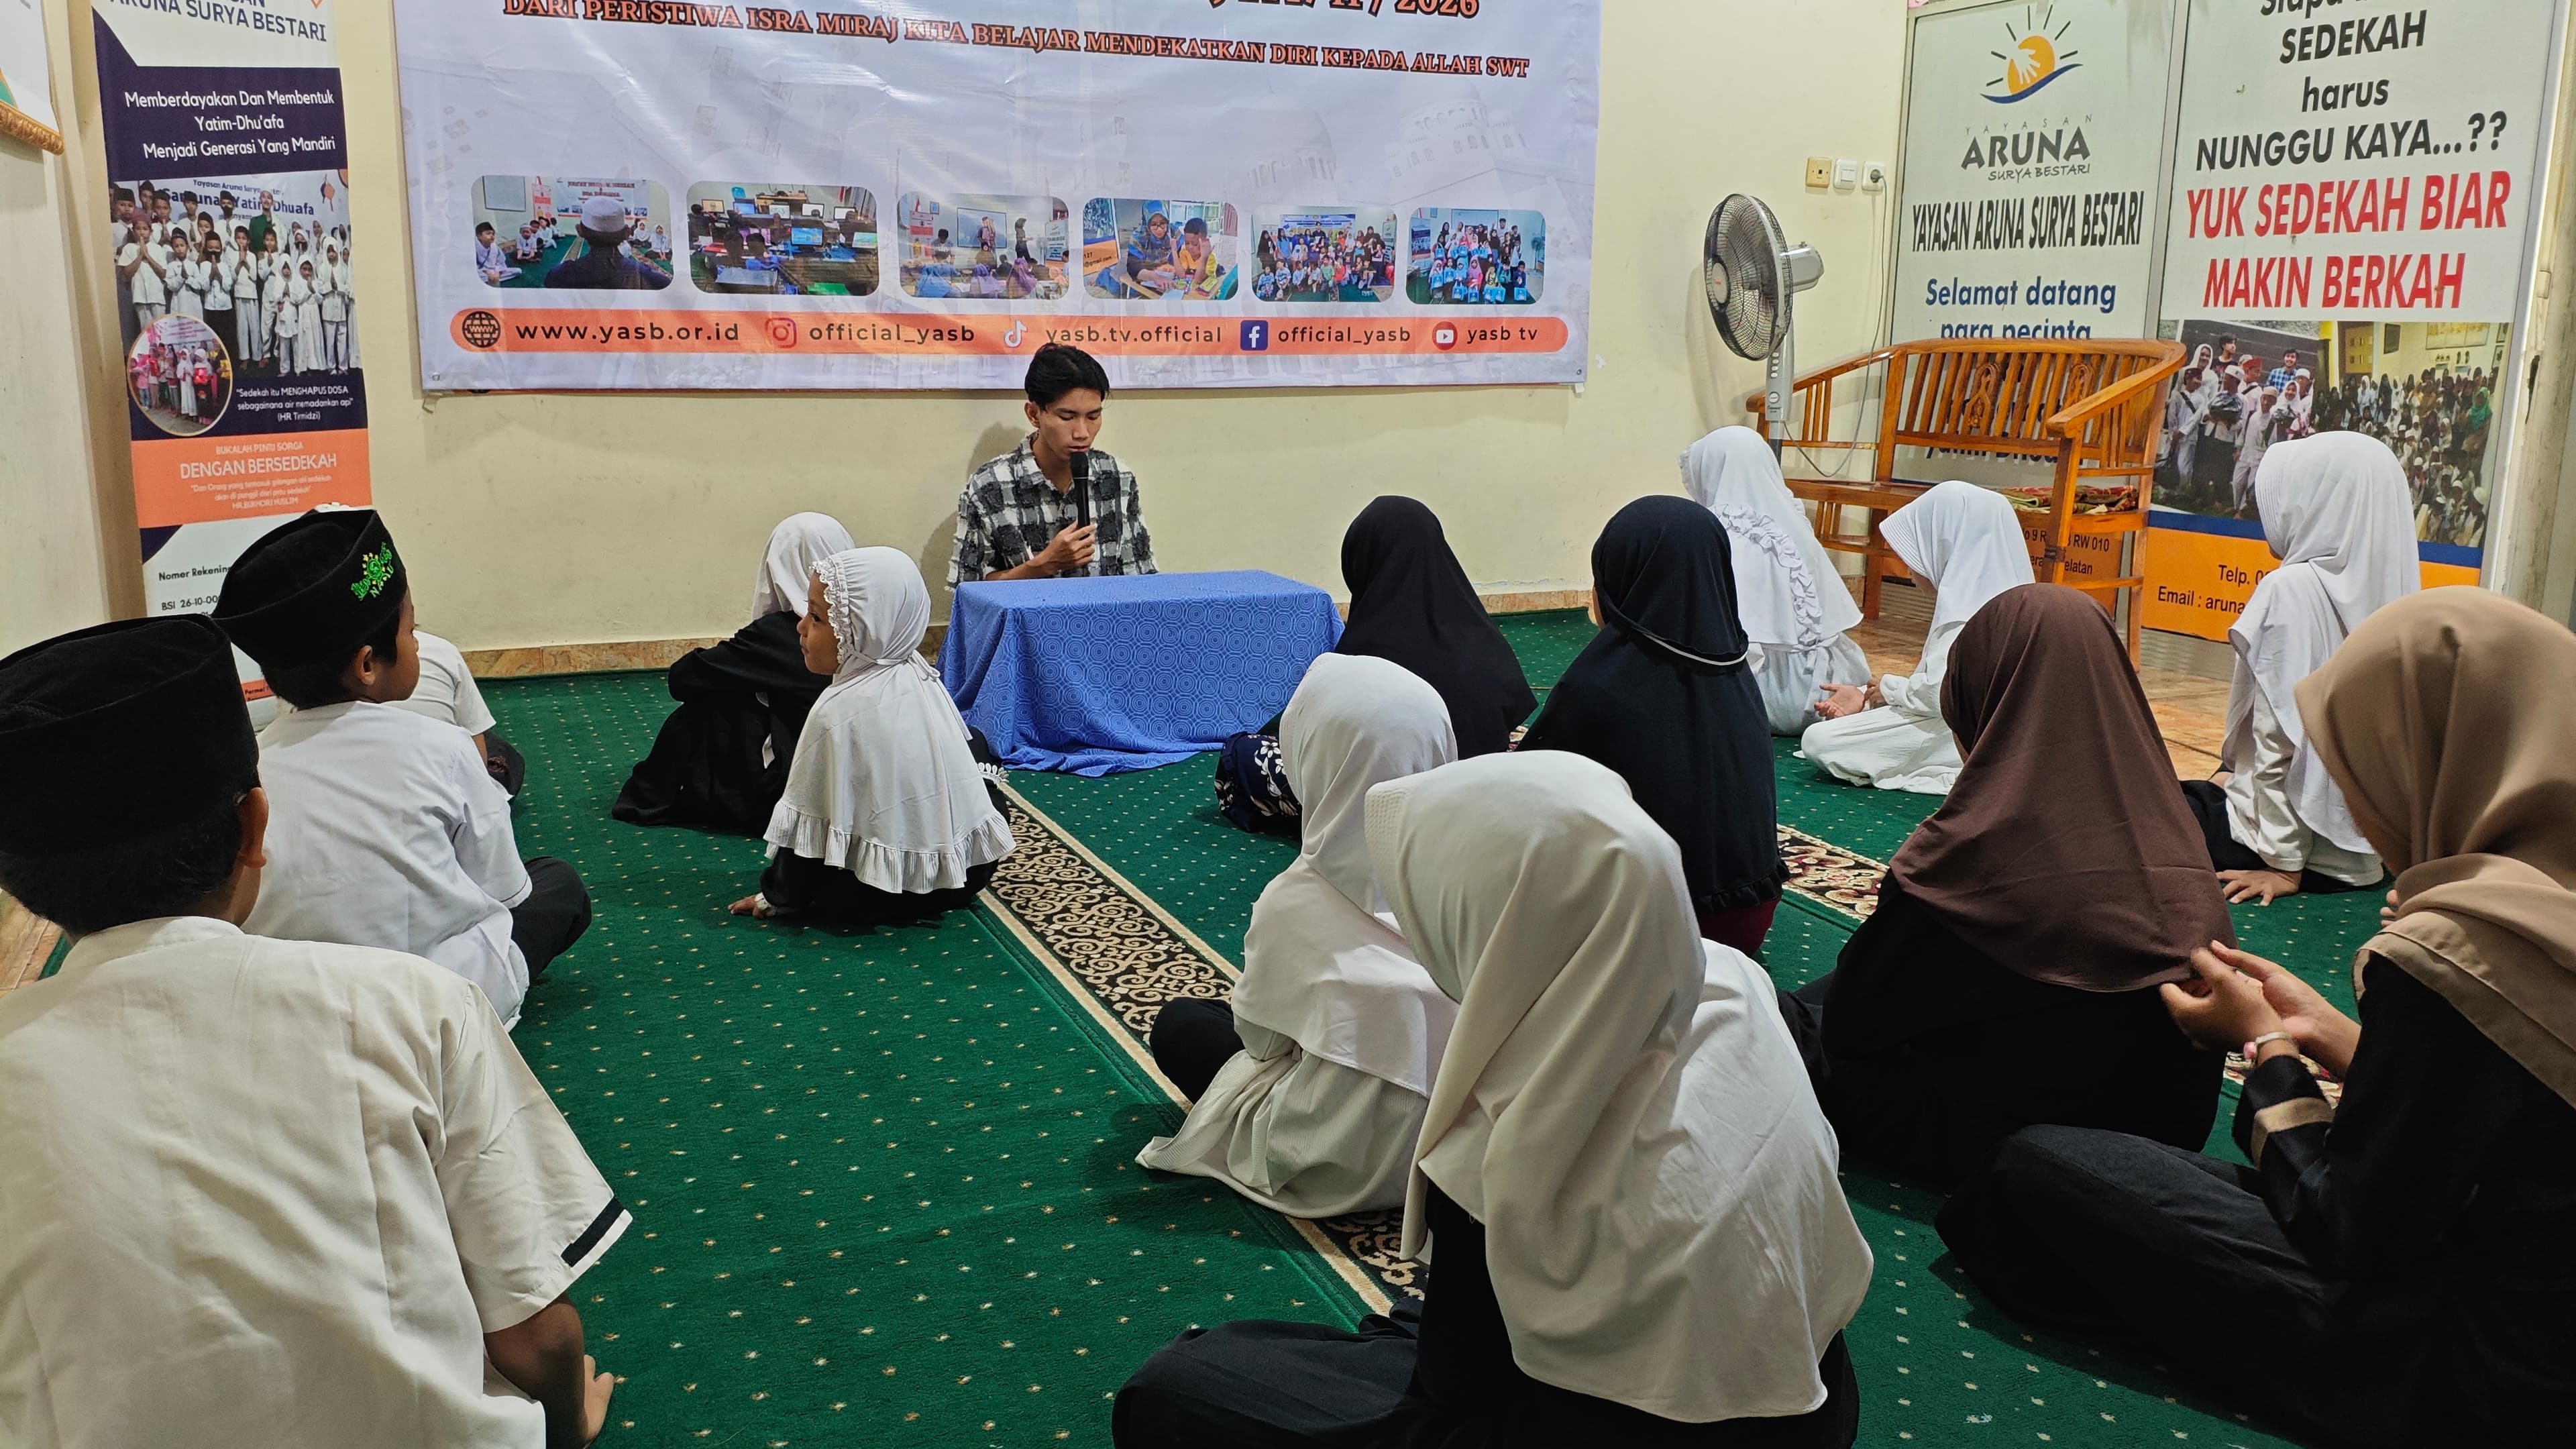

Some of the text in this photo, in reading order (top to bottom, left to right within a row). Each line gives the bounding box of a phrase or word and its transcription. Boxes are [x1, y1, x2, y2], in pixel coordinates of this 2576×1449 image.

[109, 0, 327, 42] UNA SURYA BESTARI
[503, 0, 1529, 78] DARI PERISTIWA ISRA MIRAJ KITA BELAJAR MENDEKATKAN DIRI KEPADA ALLAH SWT
[2279, 9, 2427, 64] SEDEKAH
[124, 89, 335, 110] Memberdayakan Dan Membentuk
[2301, 76, 2390, 113] harus
[194, 114, 284, 131] Yatim-Dhu'afa
[143, 136, 335, 161] Menjadi Generasi Yang Mandiri
[1960, 125, 2091, 170] ARUNA
[2196, 127, 2335, 171] NUNGGU
[1988, 164, 2090, 183] SURYA BESTARI
[193, 179, 221, 189] Yayasan
[221, 182, 244, 191] Aruna
[273, 201, 315, 215] Dhuafa
[2186, 170, 2512, 239] YUK SEDEKAH BIAR
[1912, 191, 2144, 252] YAYASAN ARUNA SURYA BESTARI
[2202, 252, 2466, 309] MAKIN BERKAH
[1925, 276, 2116, 313] Selamat datang
[515, 322, 739, 343] www.yasb.or.id
[809, 323, 975, 344] official_yasb
[1045, 325, 1221, 343] yasb.tv.official
[1278, 326, 1411, 345] official_yasb
[1466, 326, 1538, 344] yasb tv
[236, 386, 349, 397] "Sedekah itu MENGHAPUS DOSA
[215, 444, 253, 455] BUKALAH
[276, 441, 304, 451] SORGA
[180, 453, 337, 480] DENGAN BERSEDEKAH
[2032, 529, 2038, 541] 9
[2073, 534, 2090, 549] RW
[2092, 536, 2110, 552] 010
[158, 570, 189, 581] Nomer
[2064, 558, 2093, 575] elatan
[2218, 564, 2250, 588] Telp.
[161, 601, 176, 610] BSI
[2157, 586, 2195, 606] Email
